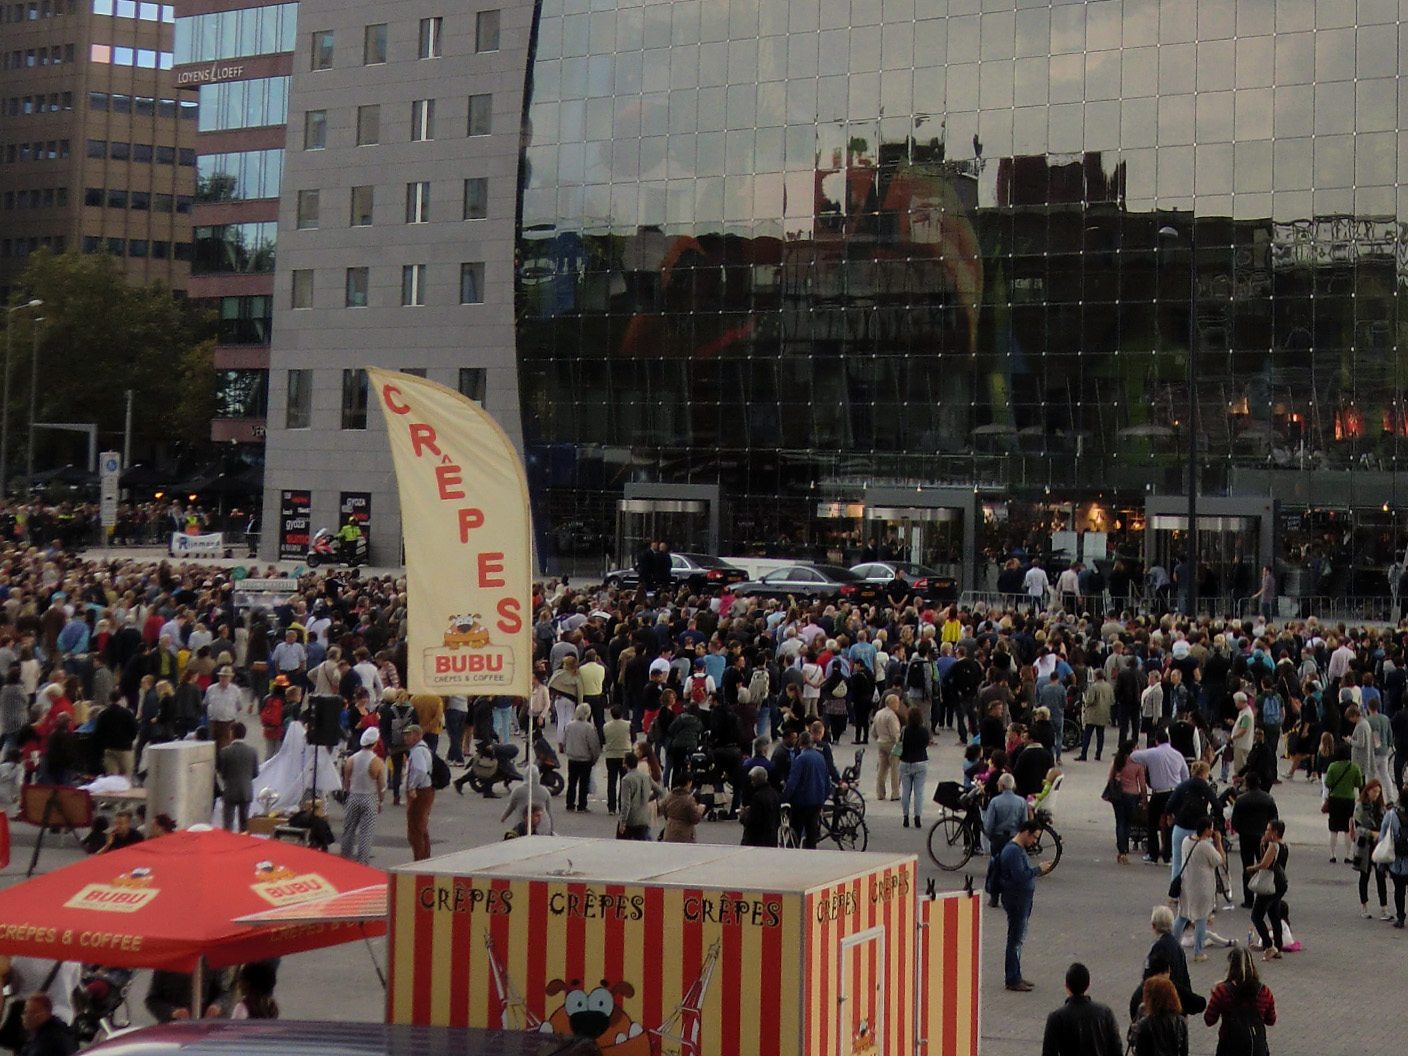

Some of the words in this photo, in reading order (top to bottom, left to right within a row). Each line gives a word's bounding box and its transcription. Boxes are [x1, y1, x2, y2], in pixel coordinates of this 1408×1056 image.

[178, 69, 210, 83] LOYENS
[217, 66, 244, 79] LOEFF
[435, 654, 503, 673] BUBU
[473, 674, 504, 682] COFFEE
[83, 890, 148, 905] BUBU
[264, 878, 322, 899] BUBU
[420, 882, 514, 915] CRÊPES
[548, 887, 645, 921] CRÊPES
[682, 893, 782, 927] CRÊPES
[817, 889, 858, 924] CRÊPES
[62, 929, 73, 944] &
[79, 930, 144, 952] COFFEE
